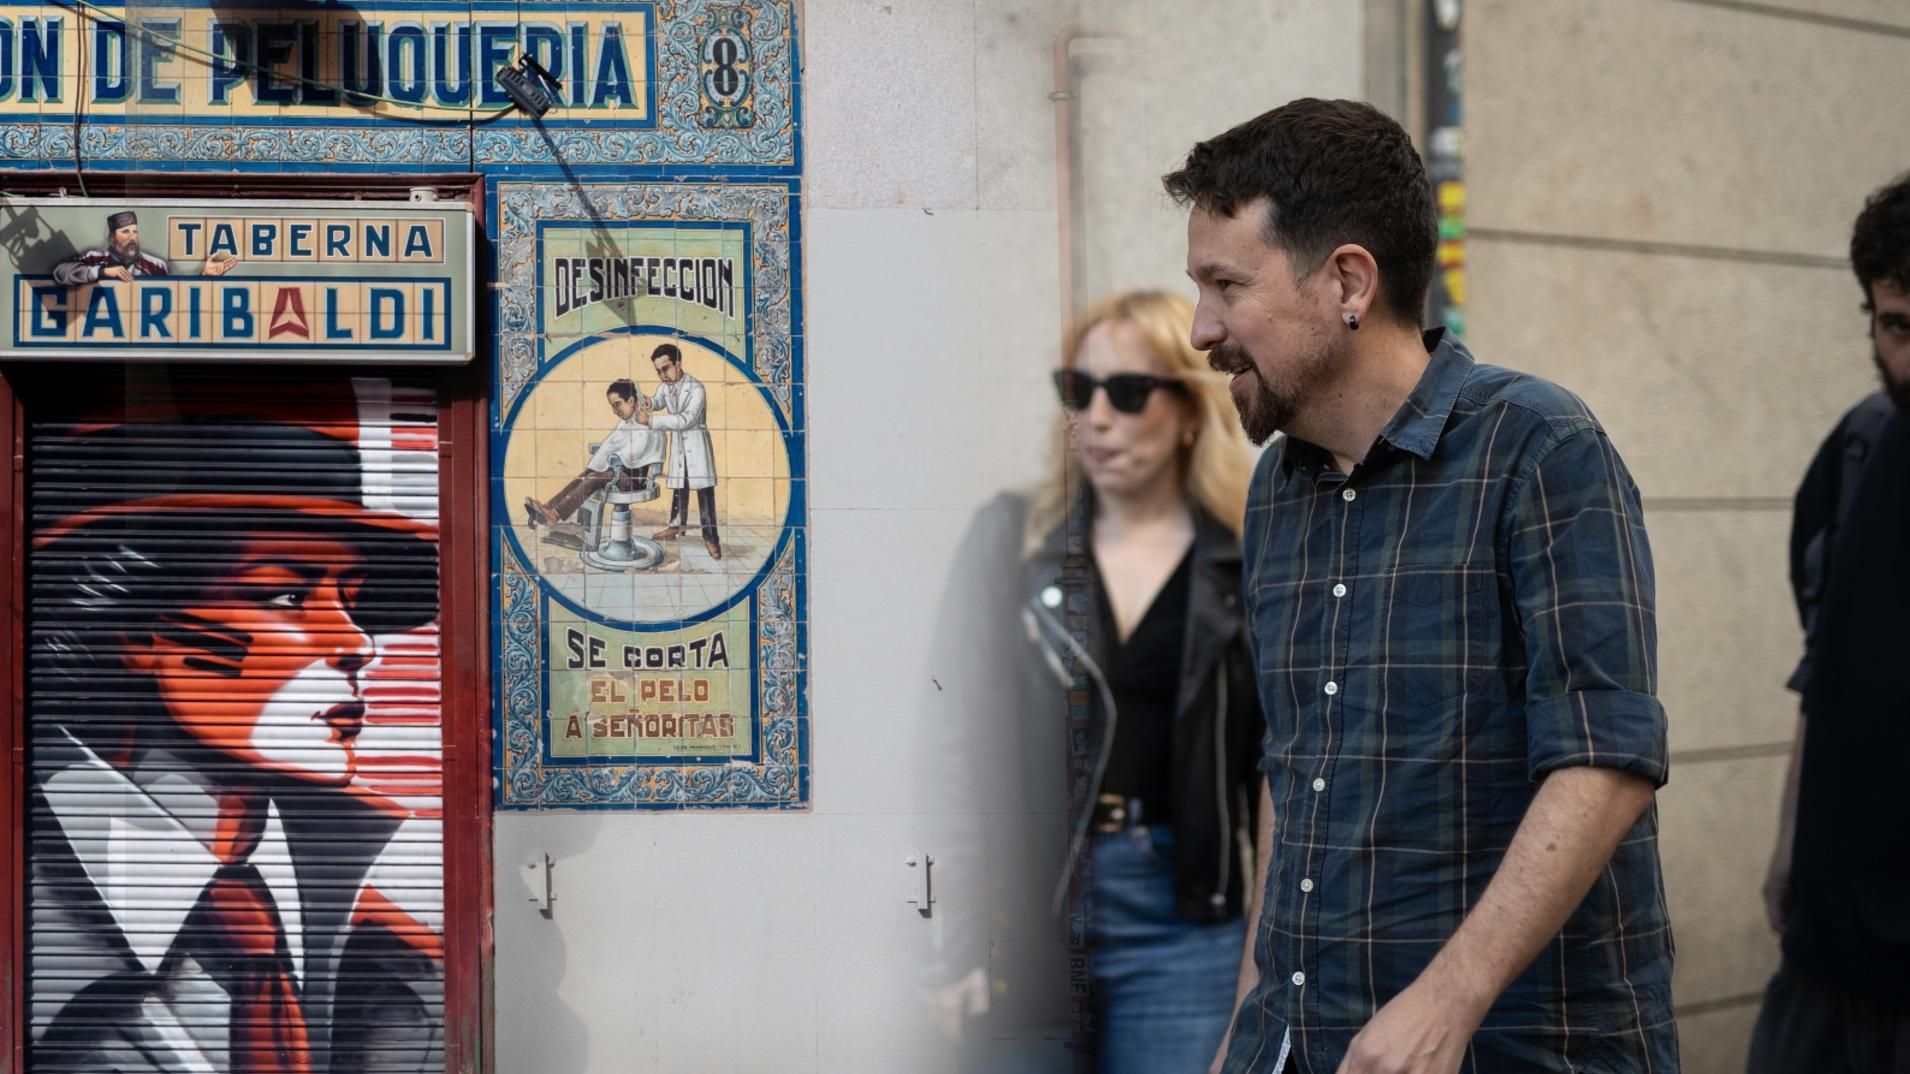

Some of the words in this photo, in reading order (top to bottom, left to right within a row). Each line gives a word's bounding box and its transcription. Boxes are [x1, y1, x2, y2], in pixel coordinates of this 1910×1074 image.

[90, 16, 182, 105] DE
[207, 18, 639, 109] PELUQUERIA
[712, 37, 739, 97] 8
[177, 222, 434, 257] TABERNA
[554, 256, 735, 319] DESINFECCION
[29, 286, 434, 341] GARIBALDI
[566, 627, 608, 670] SE
[622, 630, 730, 669] CORTA
[590, 678, 626, 704] EL
[639, 678, 711, 703] PELO
[564, 714, 583, 739] A
[592, 708, 735, 739] SEÑORITAS
